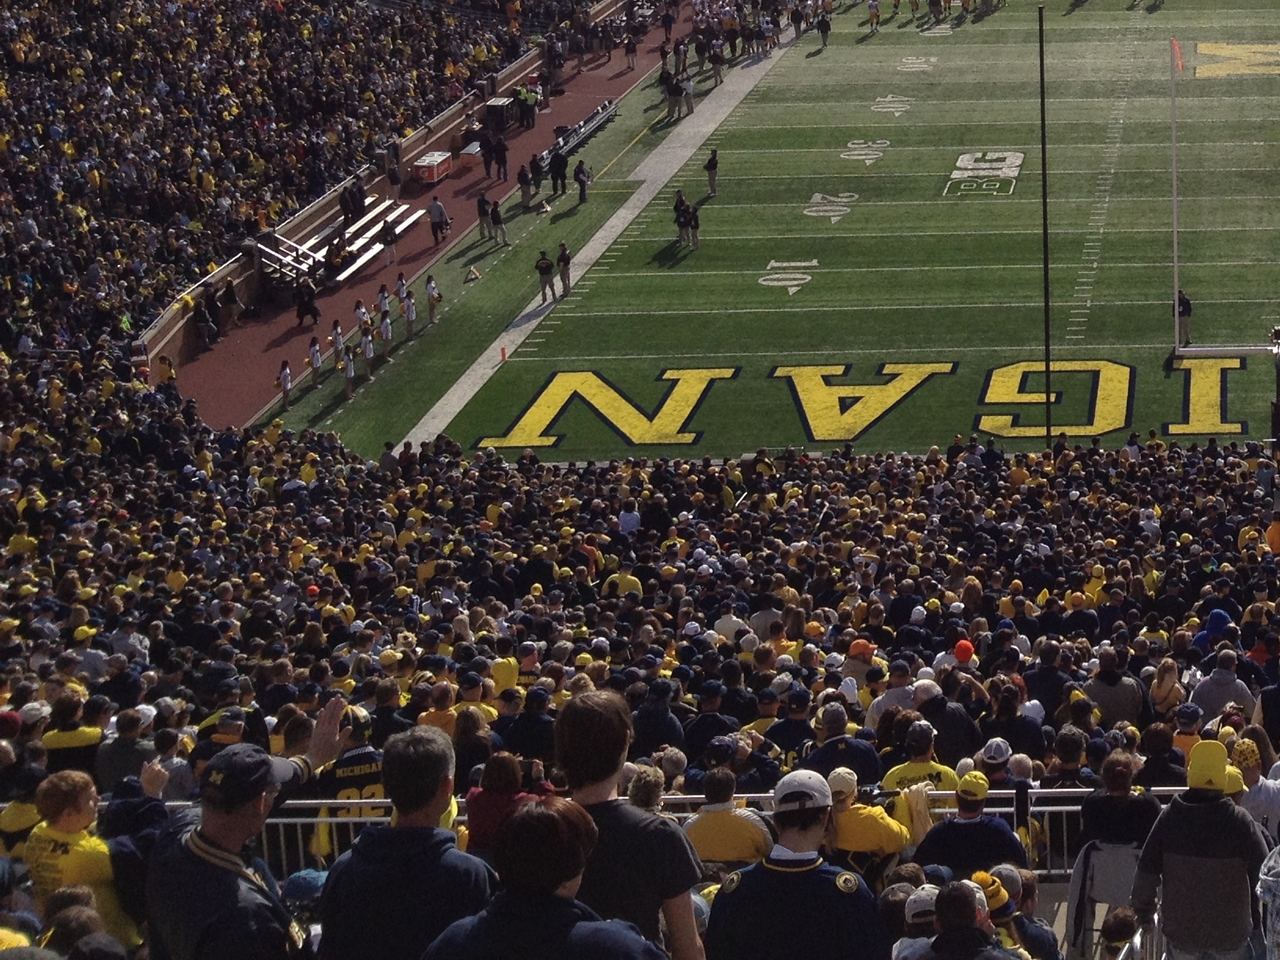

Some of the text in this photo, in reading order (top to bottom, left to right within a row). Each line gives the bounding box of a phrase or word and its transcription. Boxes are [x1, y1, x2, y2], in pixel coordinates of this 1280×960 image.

[803, 192, 860, 218] 20
[757, 258, 820, 287] 10
[209, 770, 225, 786] M
[336, 784, 385, 817] 92
